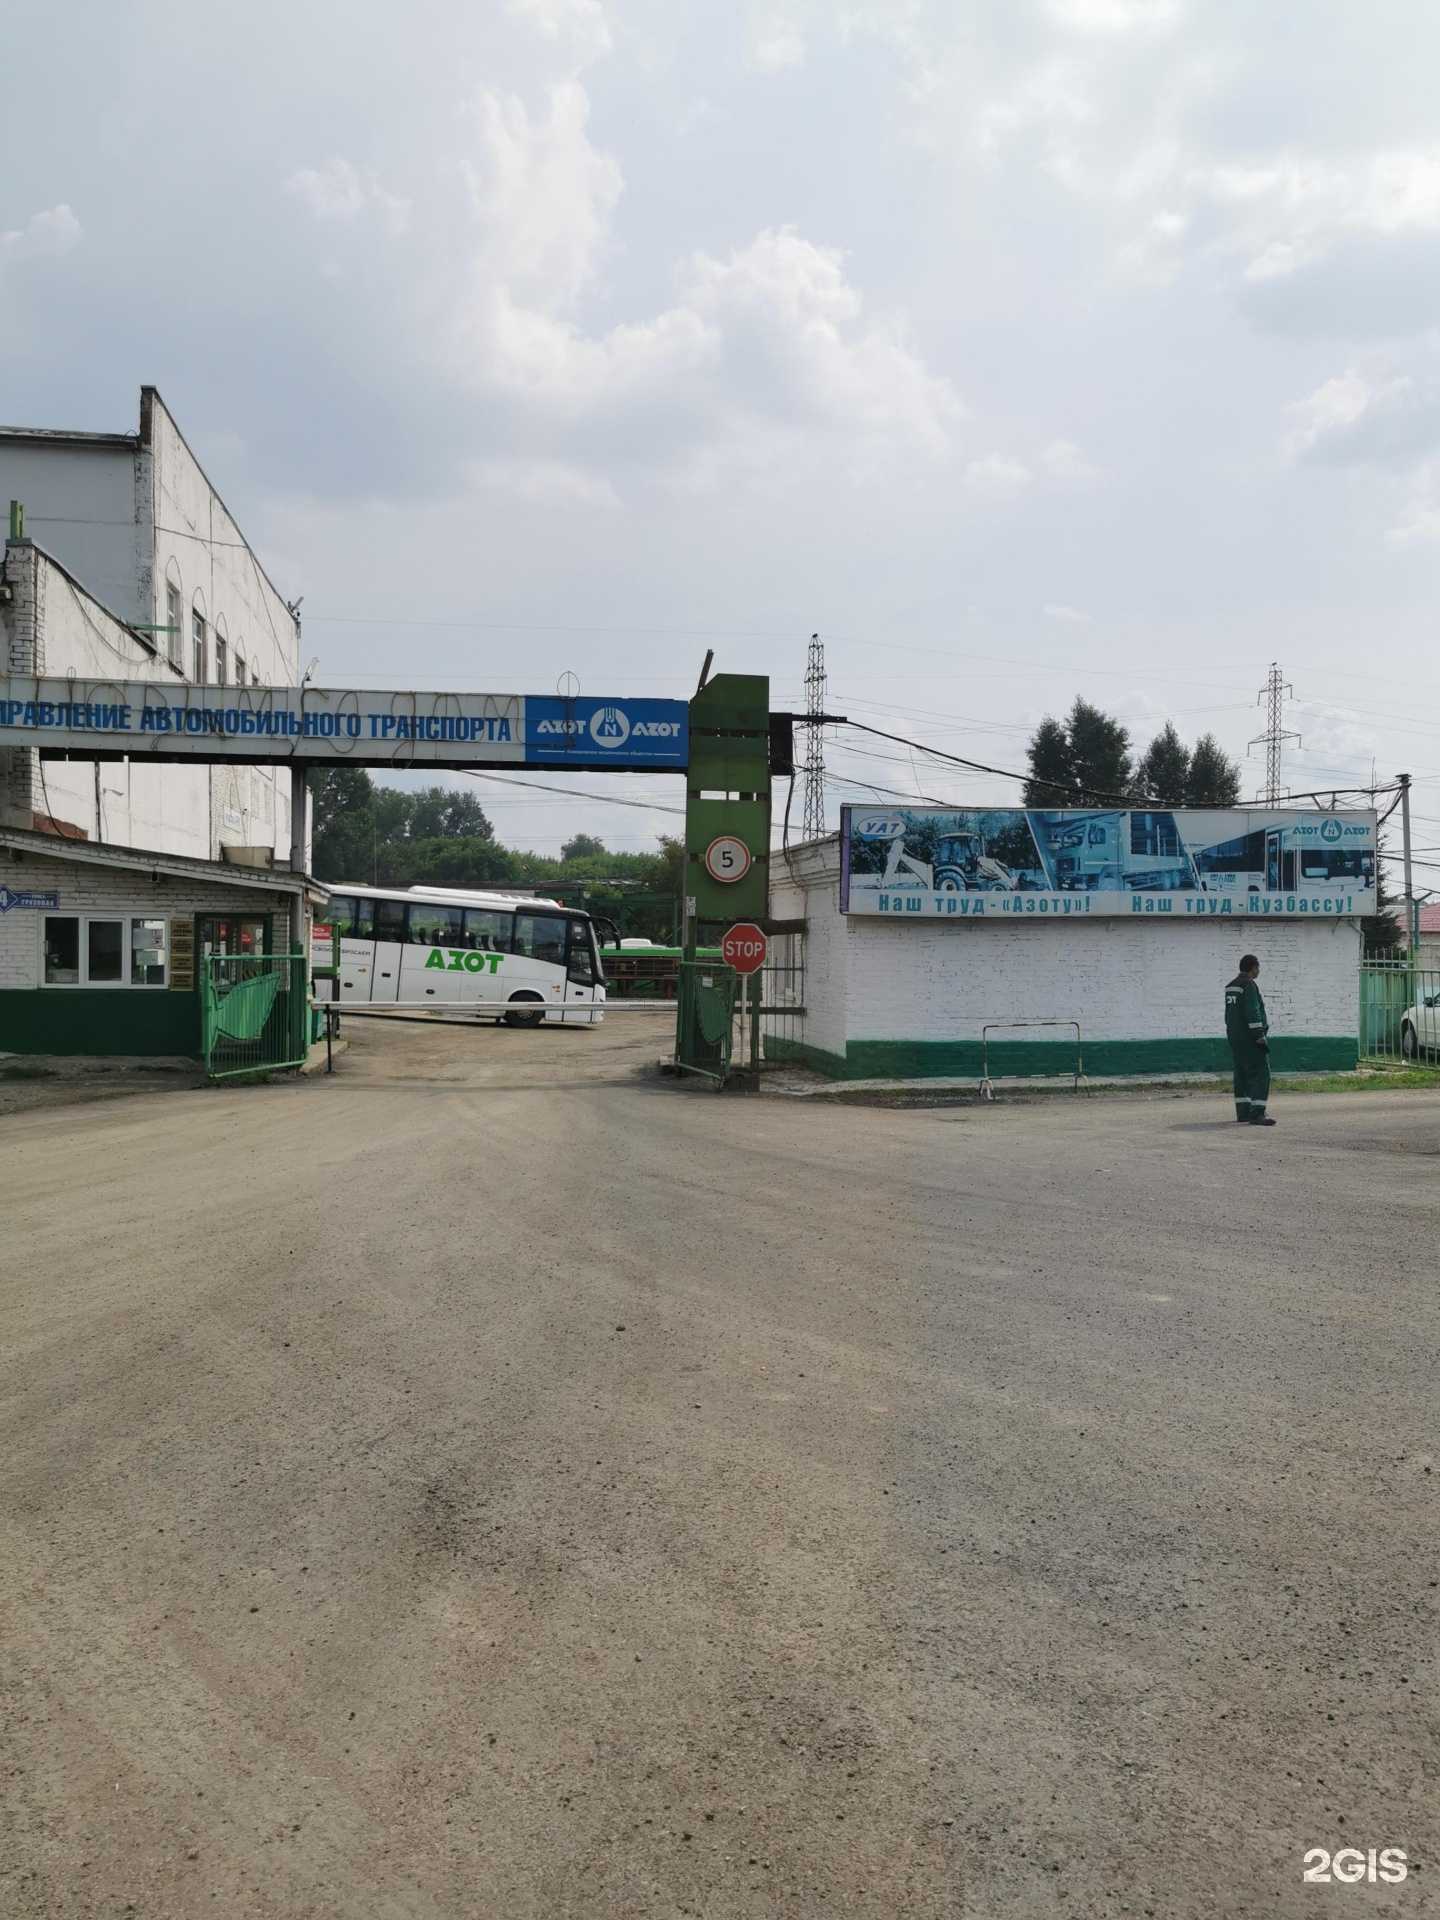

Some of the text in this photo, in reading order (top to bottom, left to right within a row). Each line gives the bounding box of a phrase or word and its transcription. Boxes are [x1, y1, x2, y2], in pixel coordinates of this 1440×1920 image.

[140, 706, 361, 737] АВТОМОБИЛЬНОГО
[367, 713, 511, 742] ТРАНСПОРТА
[536, 719, 587, 736] АЗОТ
[631, 721, 681, 737] АЗОТ
[864, 821, 900, 832] УАТ
[722, 851, 733, 868] 5
[879, 893, 922, 912] Наш
[935, 894, 985, 914] труд
[1132, 896, 1172, 912] Наш
[1185, 898, 1232, 914] труд
[1249, 895, 1353, 914] Кузбассу!
[726, 941, 762, 957] STOP
[425, 949, 504, 974] АЗОТ
